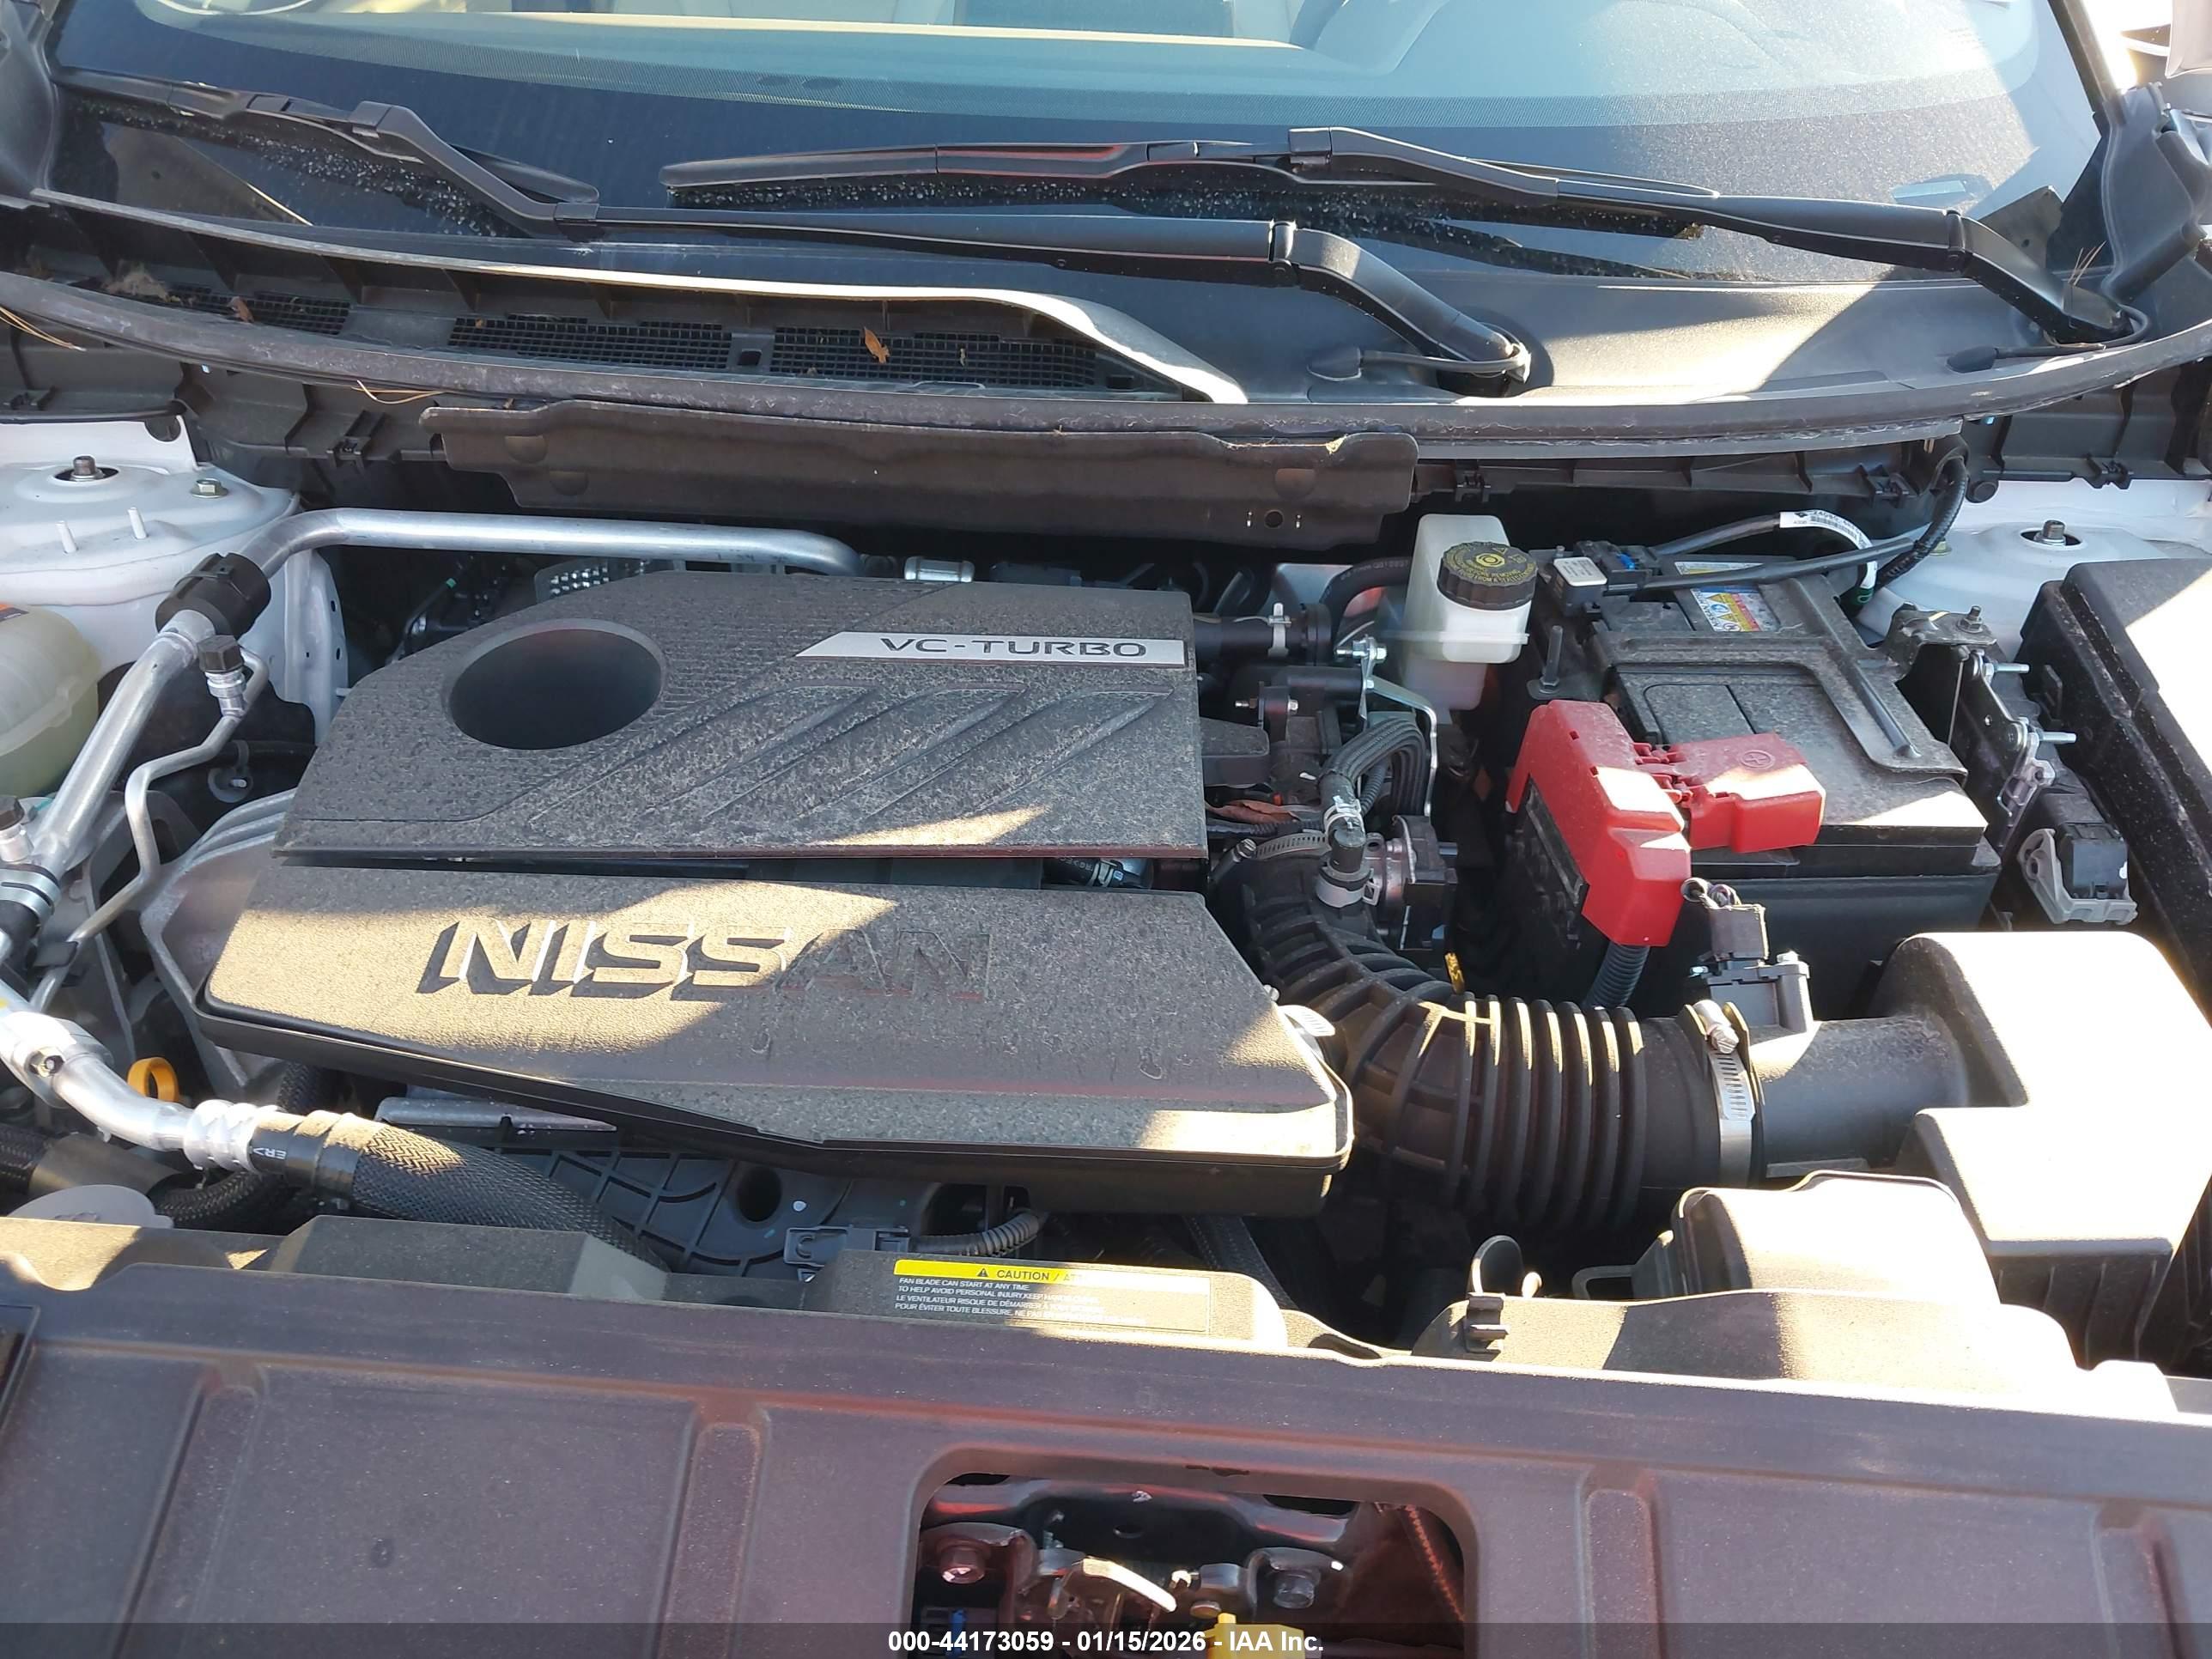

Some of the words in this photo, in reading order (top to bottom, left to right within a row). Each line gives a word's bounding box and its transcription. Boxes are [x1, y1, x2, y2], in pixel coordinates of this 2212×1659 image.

[879, 638, 1147, 658] VC-TURBO
[416, 919, 990, 1001] NISSAN
[996, 1269, 1049, 1280] CAUTION
[955, 1288, 997, 1297] PERSONAL
[907, 1295, 957, 1304] VENTILATEUR
[957, 1297, 987, 1306] RISQUE
[918, 1303, 945, 1312] ÉVITER
[945, 1305, 971, 1314] TOUTE
